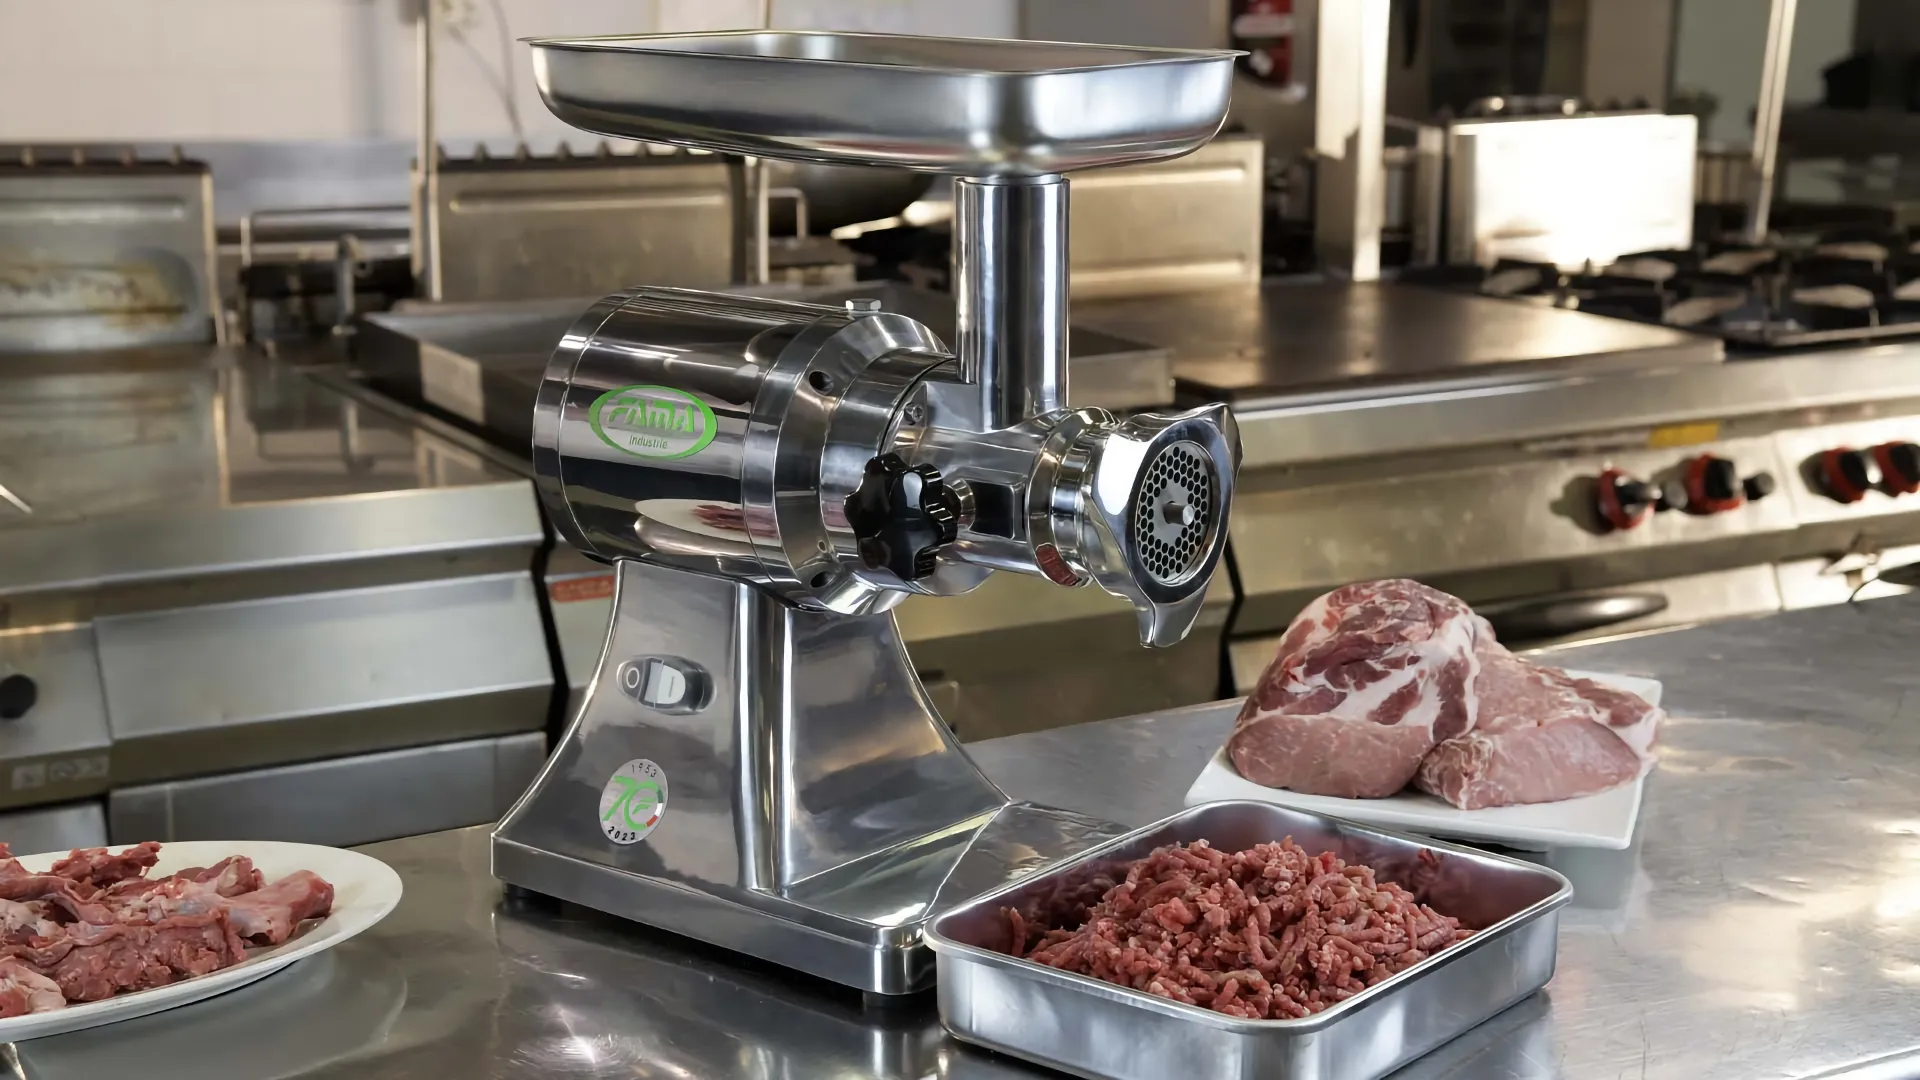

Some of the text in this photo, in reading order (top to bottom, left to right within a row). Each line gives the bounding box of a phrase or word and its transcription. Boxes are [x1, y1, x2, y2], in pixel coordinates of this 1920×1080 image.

[608, 397, 694, 432] FAMA
[631, 763, 657, 777] 1953
[608, 826, 636, 841] 2023
